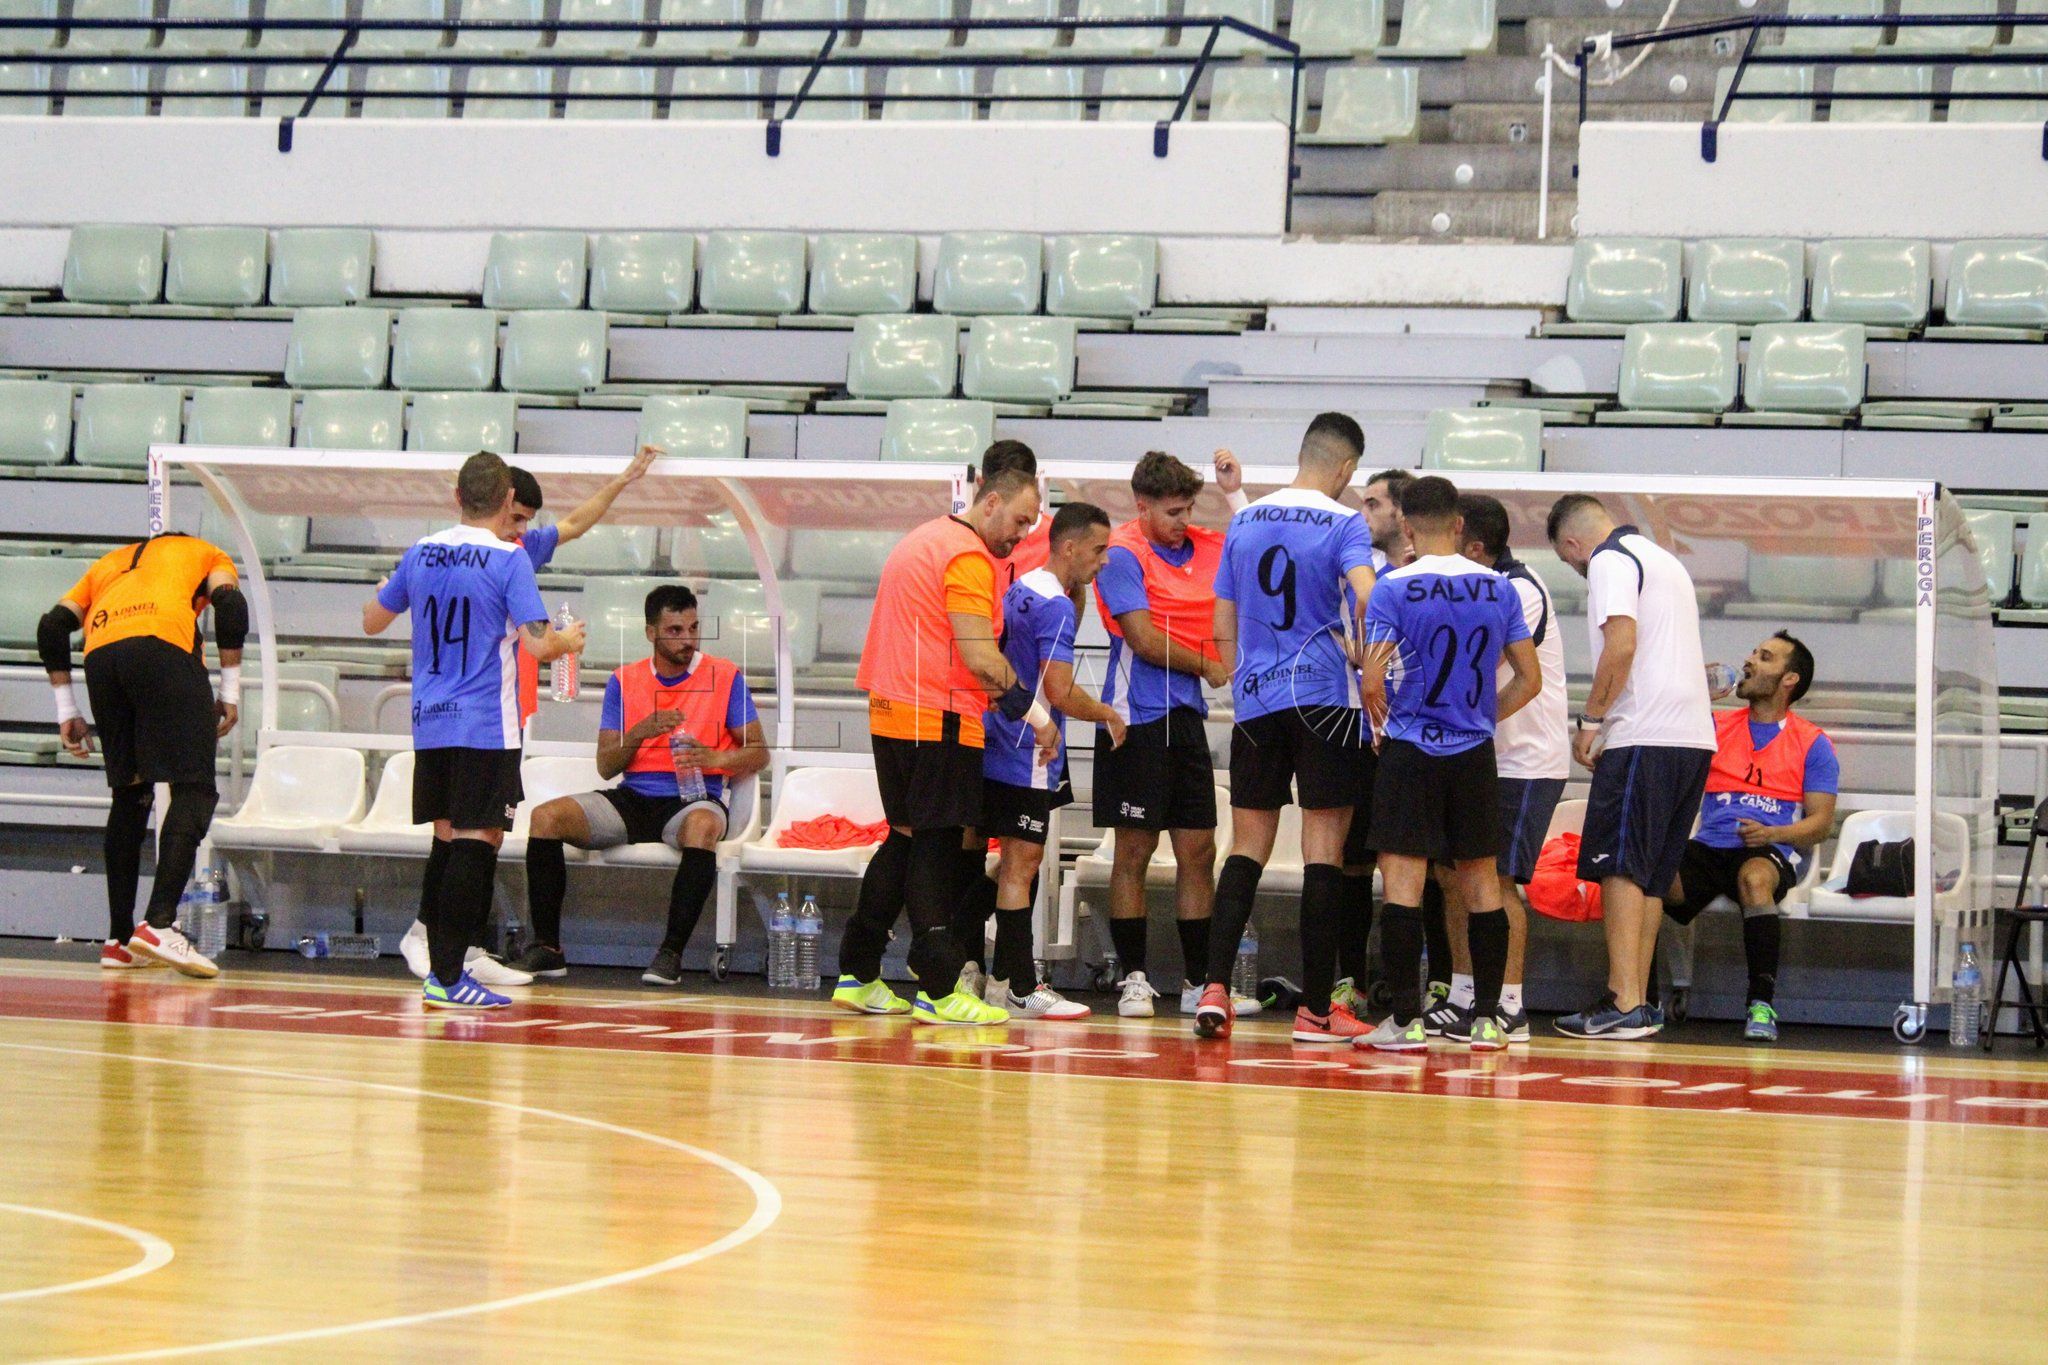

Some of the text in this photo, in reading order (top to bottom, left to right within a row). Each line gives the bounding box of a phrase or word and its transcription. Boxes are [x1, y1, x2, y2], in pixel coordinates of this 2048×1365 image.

[418, 545, 491, 569] FERNAN
[1258, 545, 1296, 631] 9
[1406, 578, 1499, 602] SALVI
[1918, 517, 1933, 607] PEROGA
[423, 594, 470, 677] 14
[1262, 663, 1317, 683] ADIMEL
[1424, 624, 1489, 709] 23
